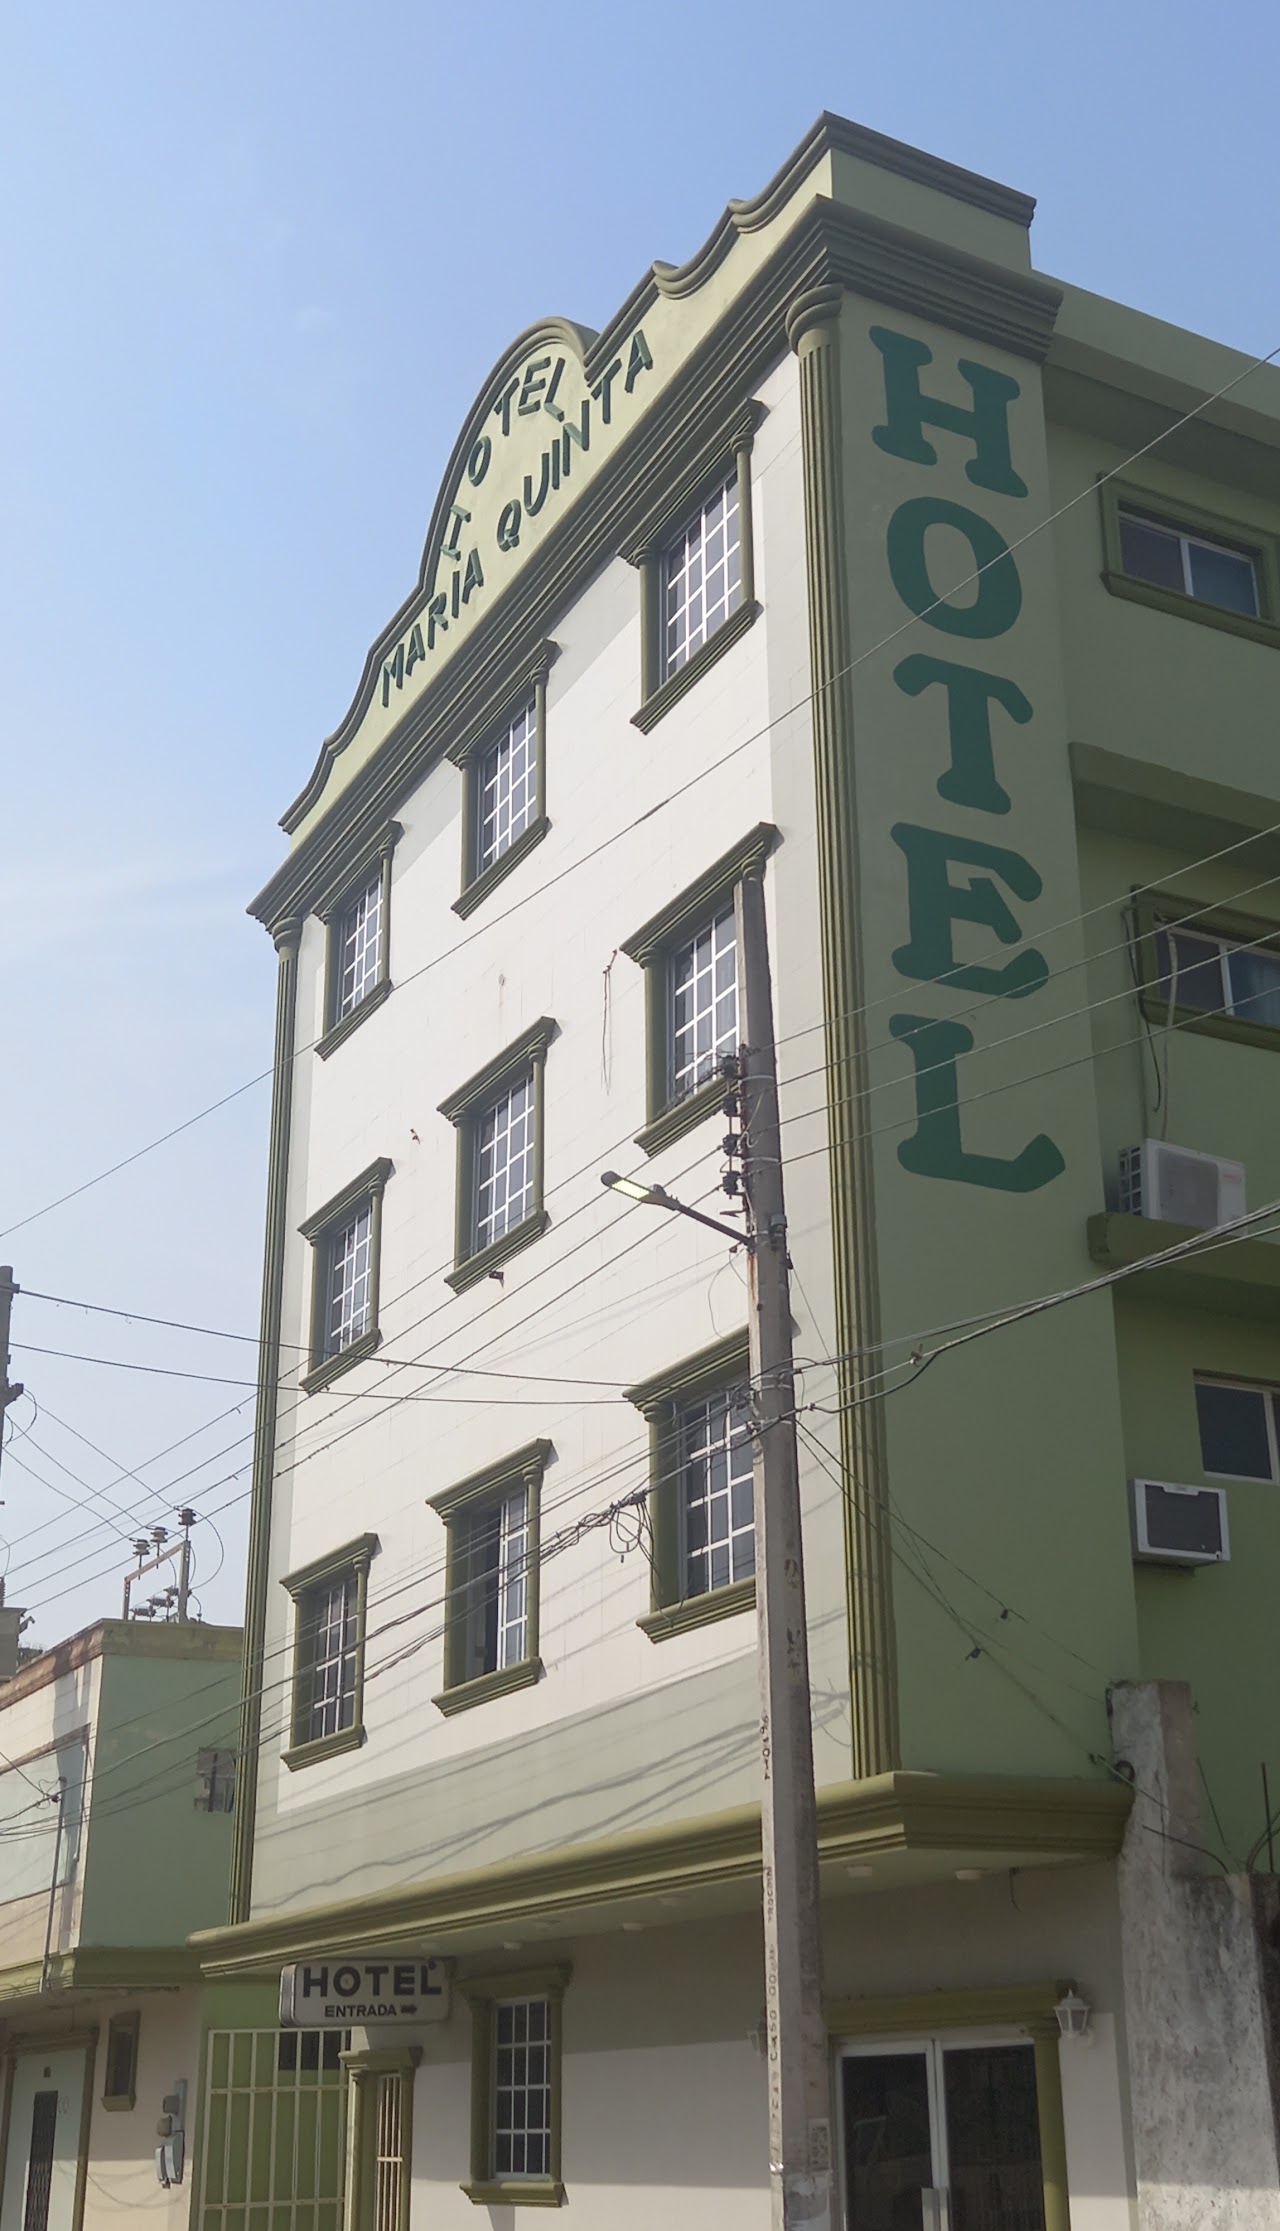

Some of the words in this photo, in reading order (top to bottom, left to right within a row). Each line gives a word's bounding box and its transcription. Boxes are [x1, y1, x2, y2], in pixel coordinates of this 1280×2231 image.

[382, 547, 484, 708] MARIA
[496, 329, 653, 552] QUINTA
[440, 356, 566, 561] HOTEL
[869, 325, 1066, 1193] HOTEL
[303, 1965, 442, 1998] HOTEL
[324, 2004, 397, 2018] ENTRADA
